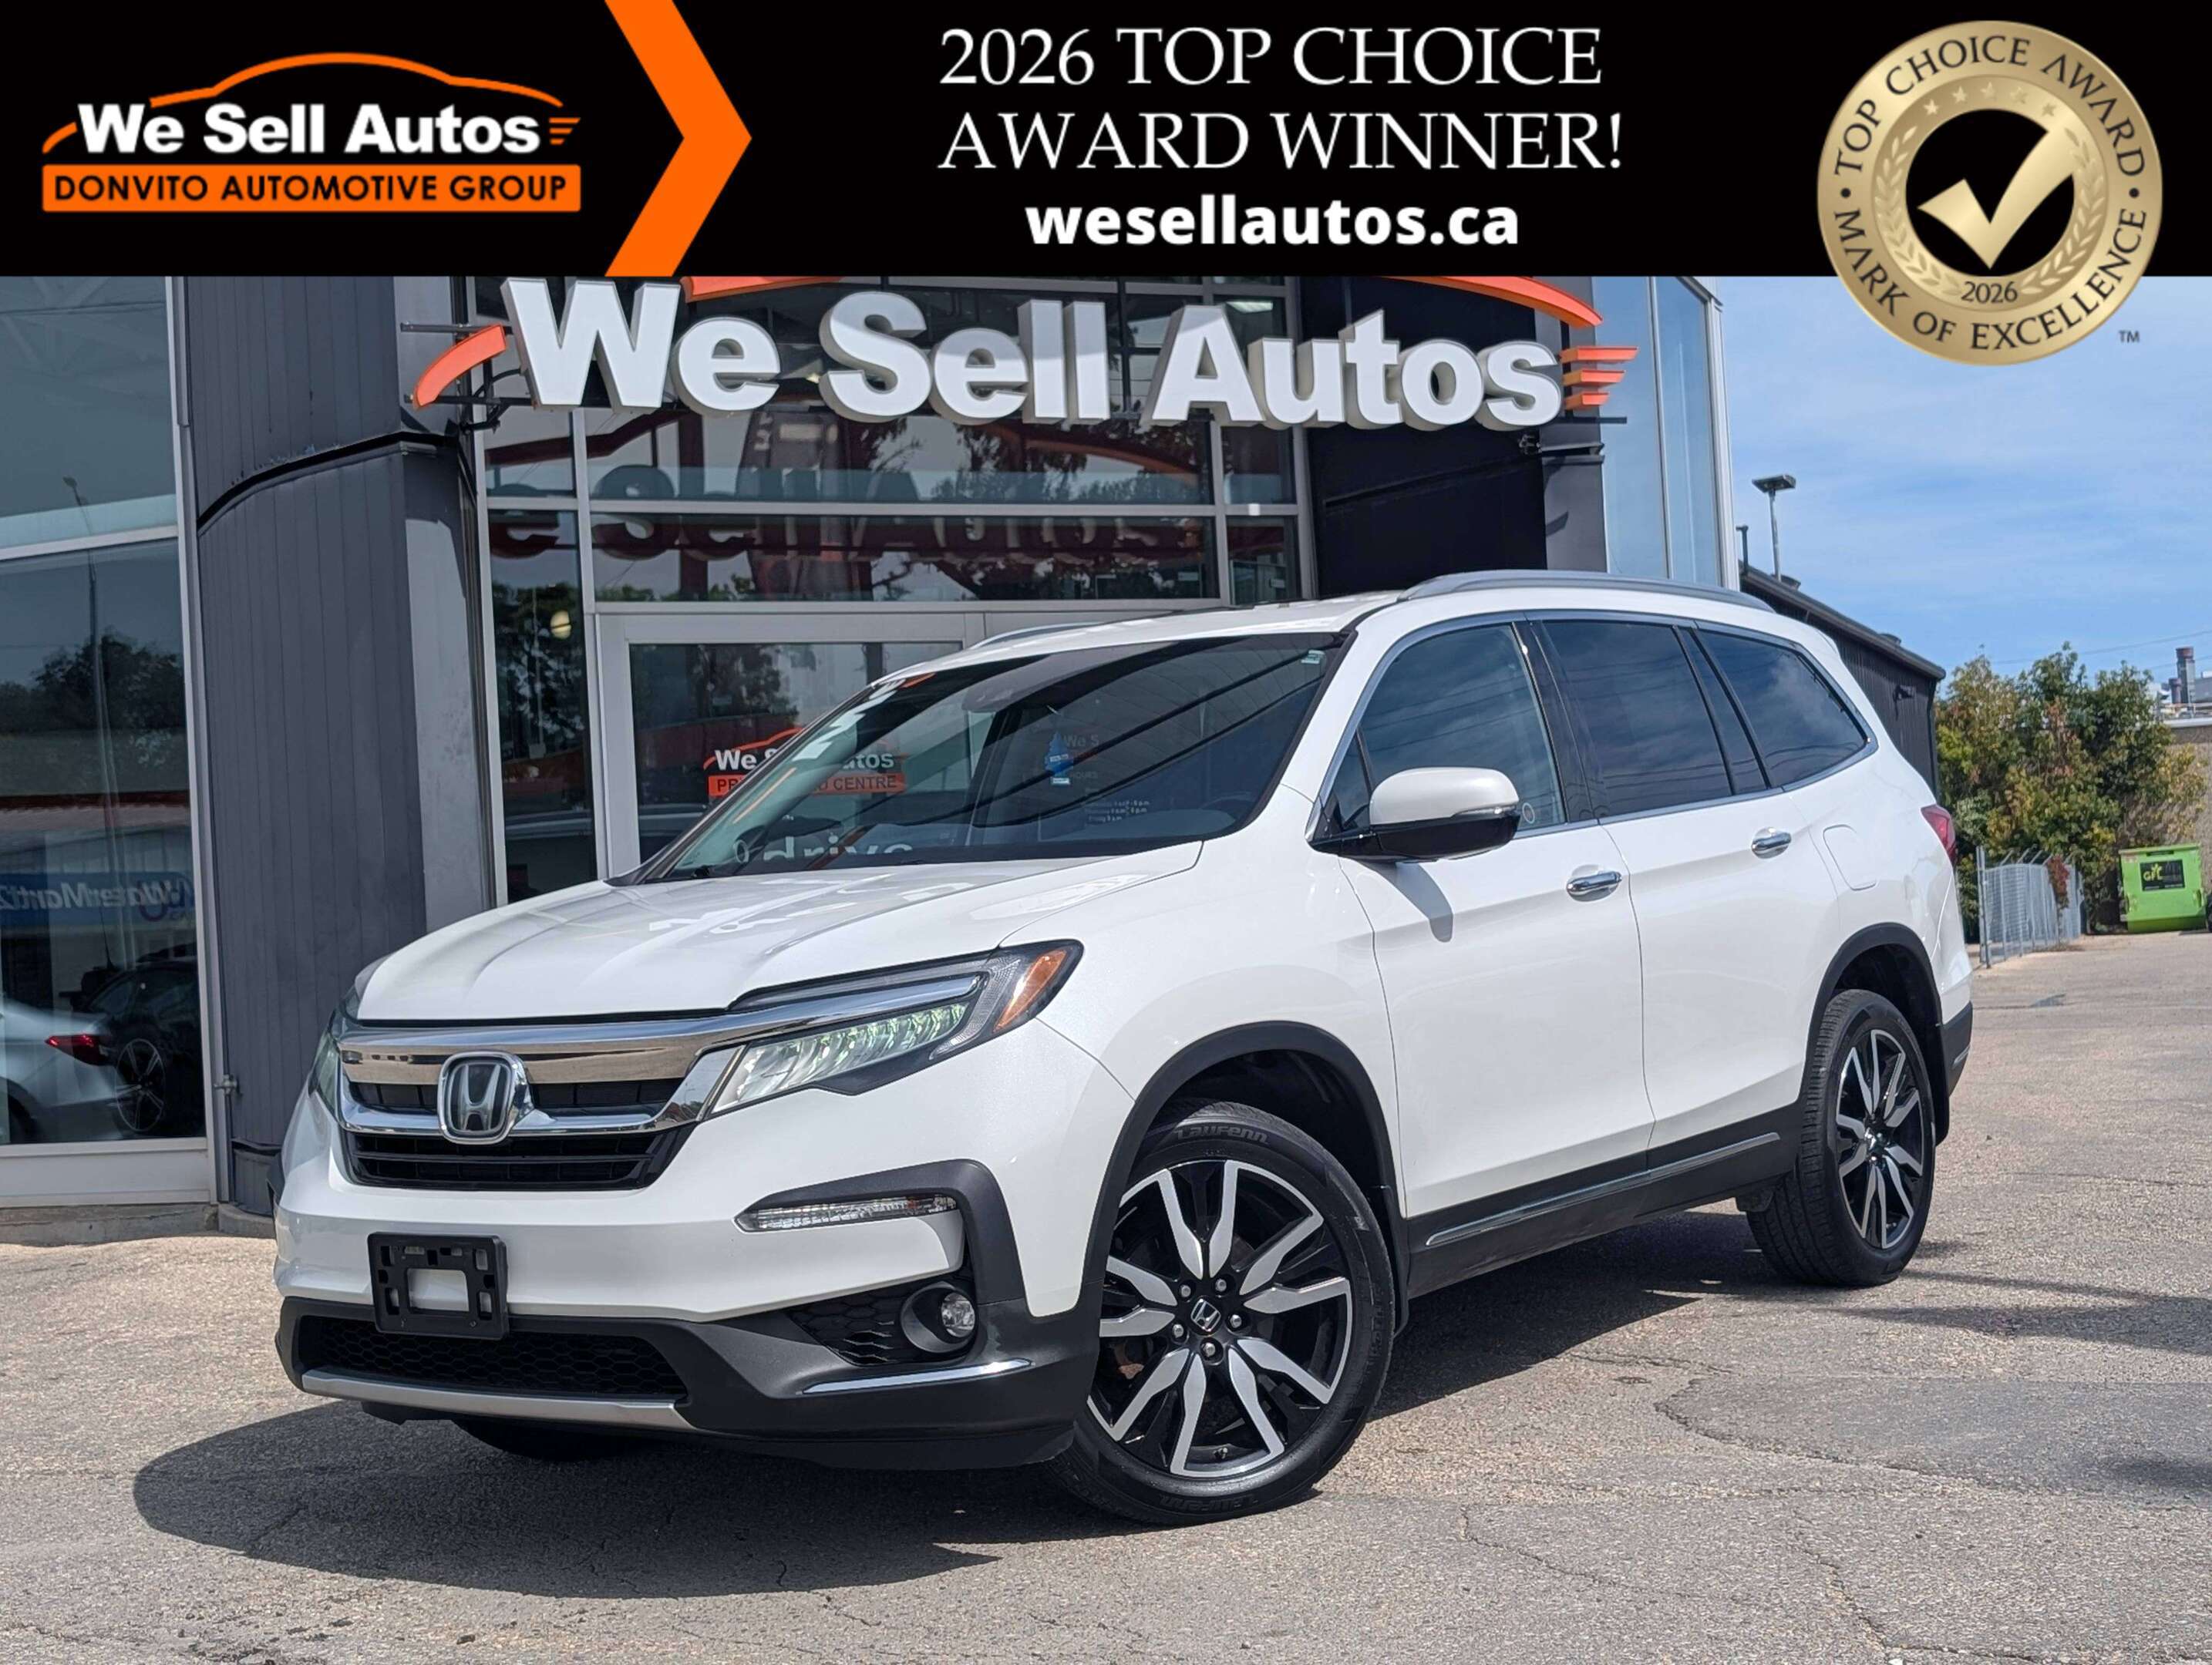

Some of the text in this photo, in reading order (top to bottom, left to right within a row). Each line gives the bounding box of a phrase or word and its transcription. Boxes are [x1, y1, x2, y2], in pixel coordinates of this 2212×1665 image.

[500, 278, 1564, 432] We Sell Autos
[714, 749, 757, 770] We
[843, 752, 894, 770] tos
[833, 775, 897, 790] CENTRE
